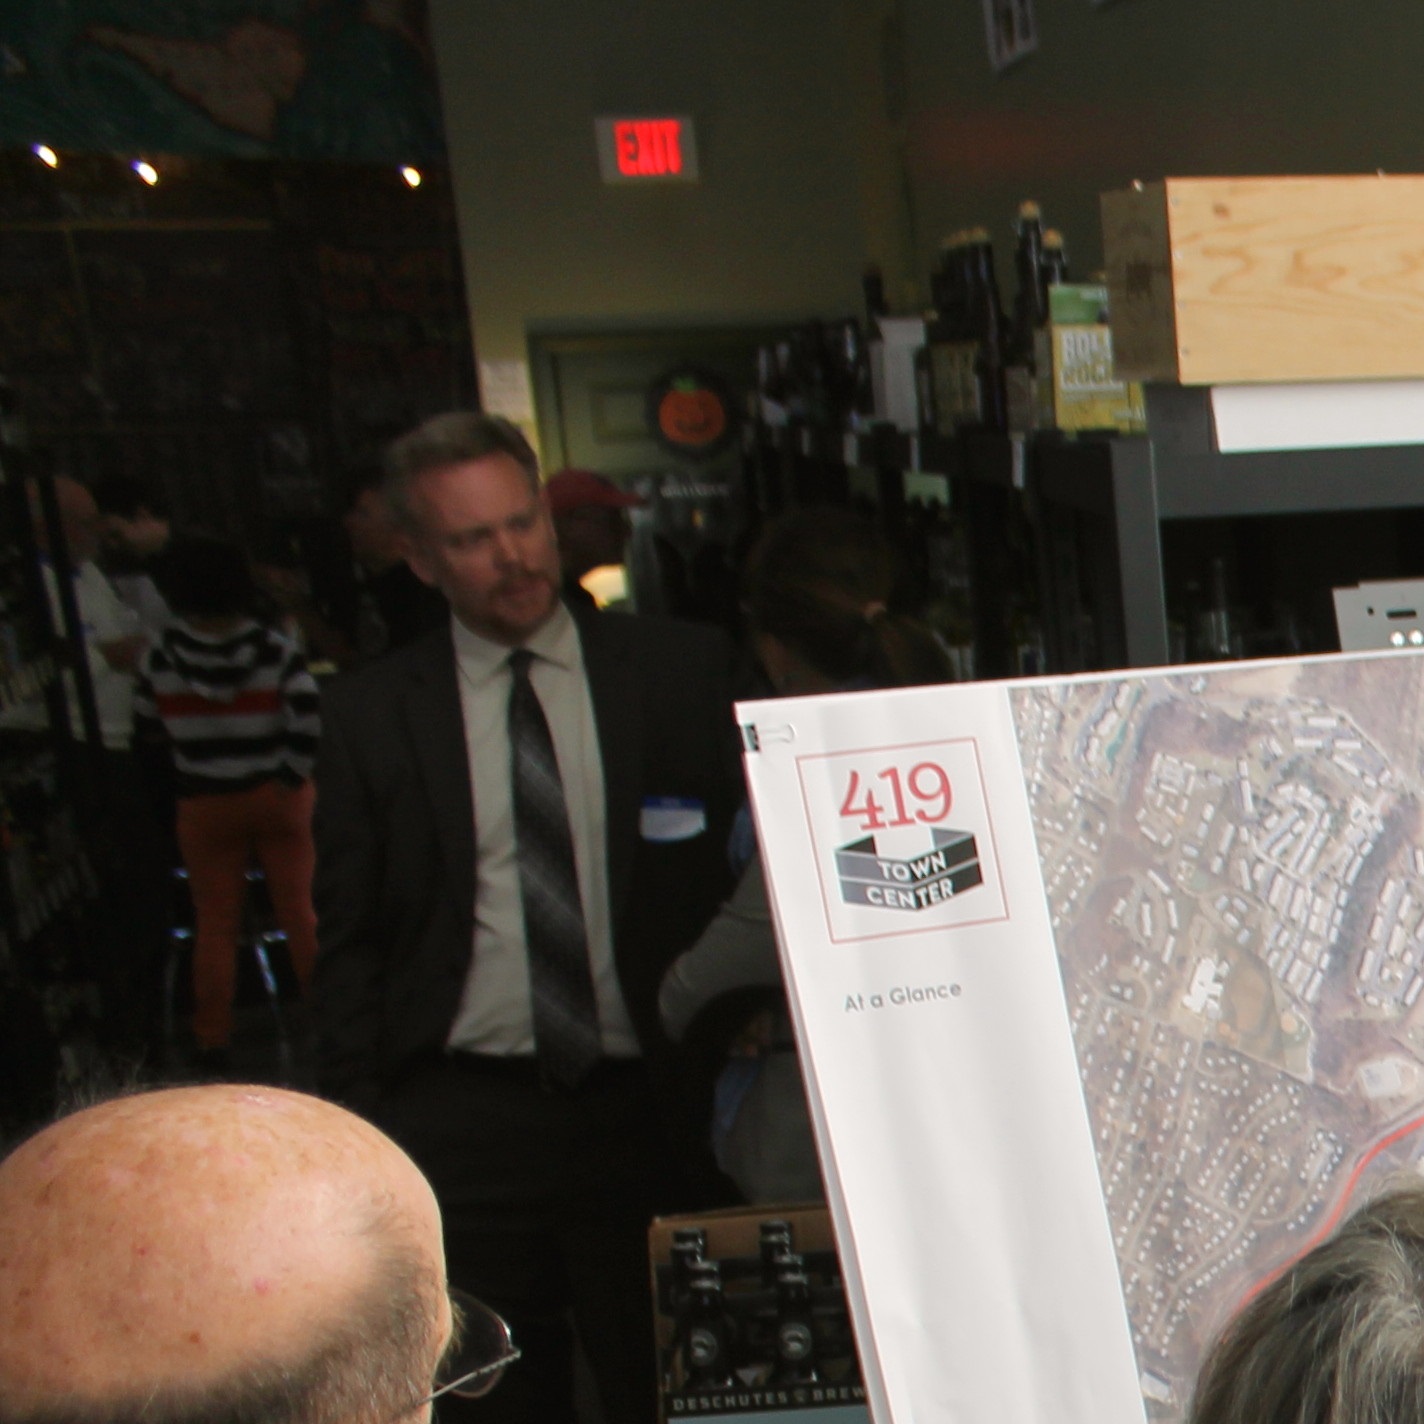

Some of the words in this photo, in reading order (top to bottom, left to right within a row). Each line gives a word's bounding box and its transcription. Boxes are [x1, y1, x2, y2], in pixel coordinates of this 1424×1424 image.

[613, 118, 683, 176] EXIT
[838, 761, 953, 831] 419
[876, 850, 948, 882] TOWN
[866, 877, 956, 909] CENTER
[843, 992, 865, 1013] At
[869, 992, 884, 1009] a
[889, 981, 963, 1005] Glance
[671, 1390, 789, 1412] DESCHUTES
